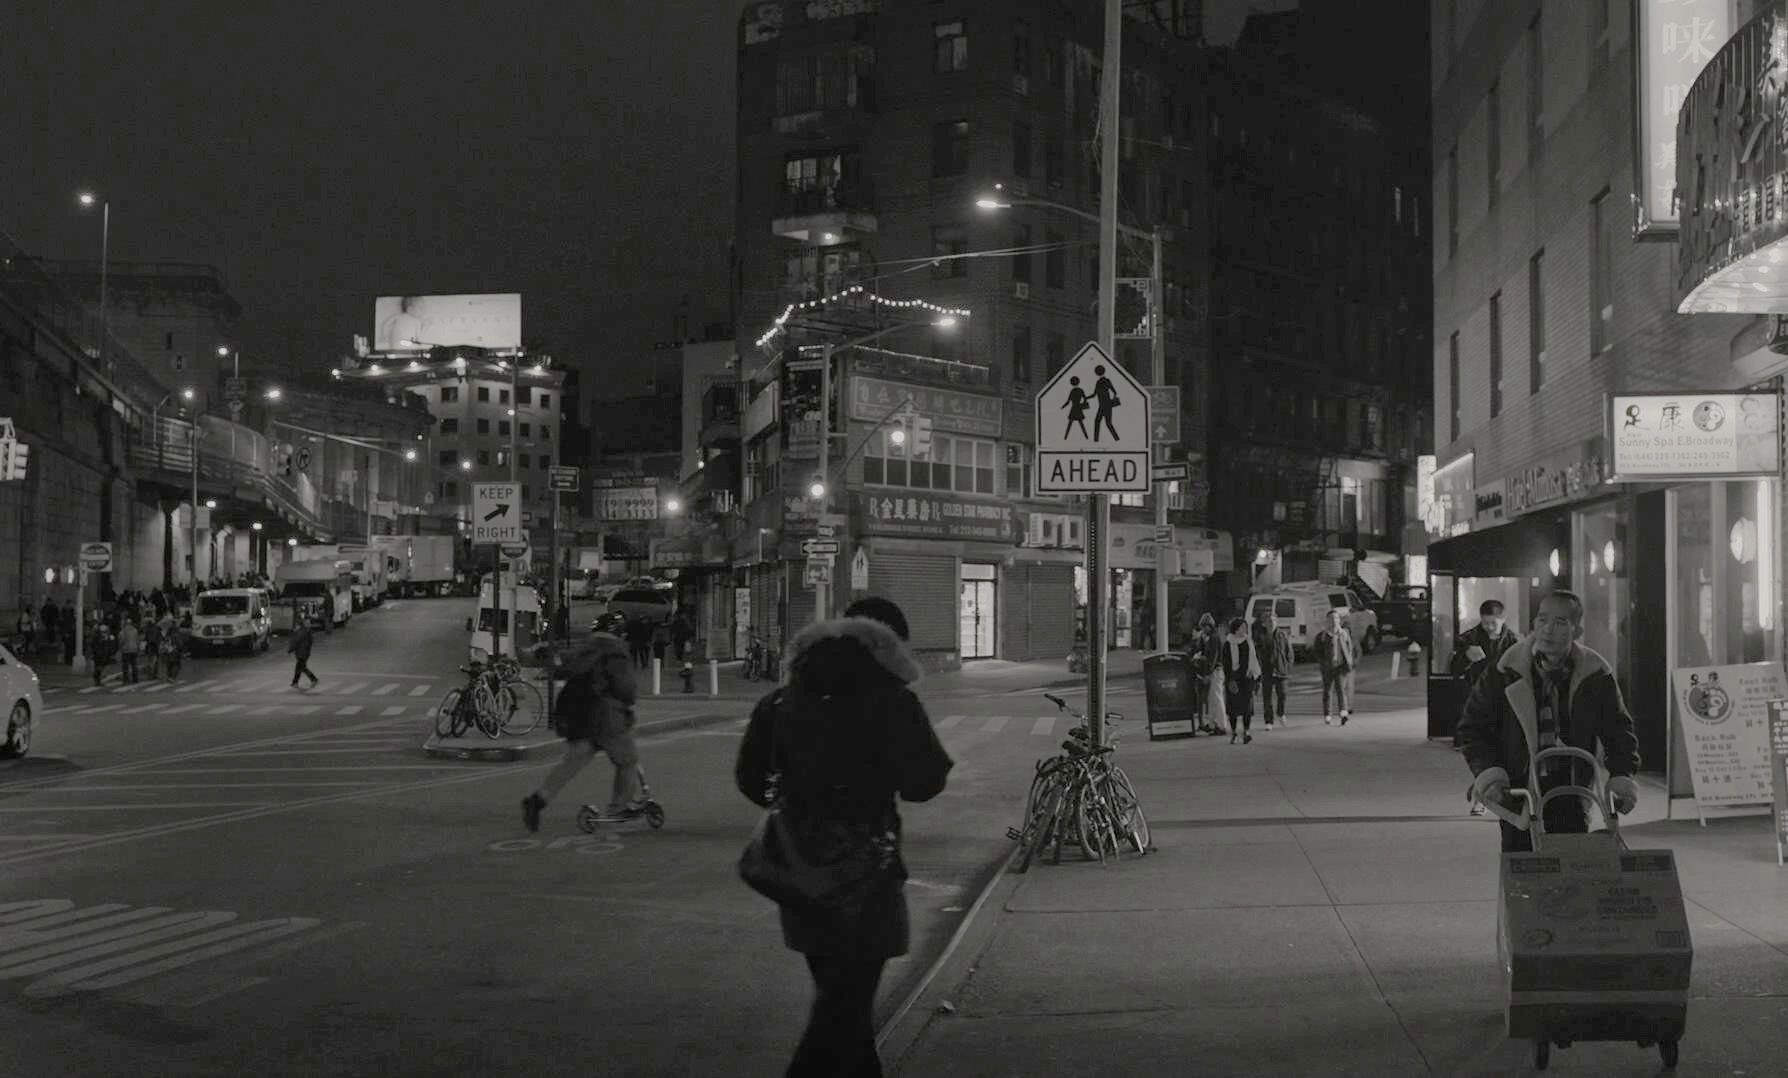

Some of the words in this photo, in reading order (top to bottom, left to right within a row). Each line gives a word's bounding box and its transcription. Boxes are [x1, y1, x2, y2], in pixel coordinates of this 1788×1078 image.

[1619, 437, 1651, 448] Sunny
[1654, 437, 1674, 447] Spa
[1051, 457, 1138, 484] AHEAD
[480, 487, 514, 499] KEEP
[477, 527, 516, 538] RIGHT
